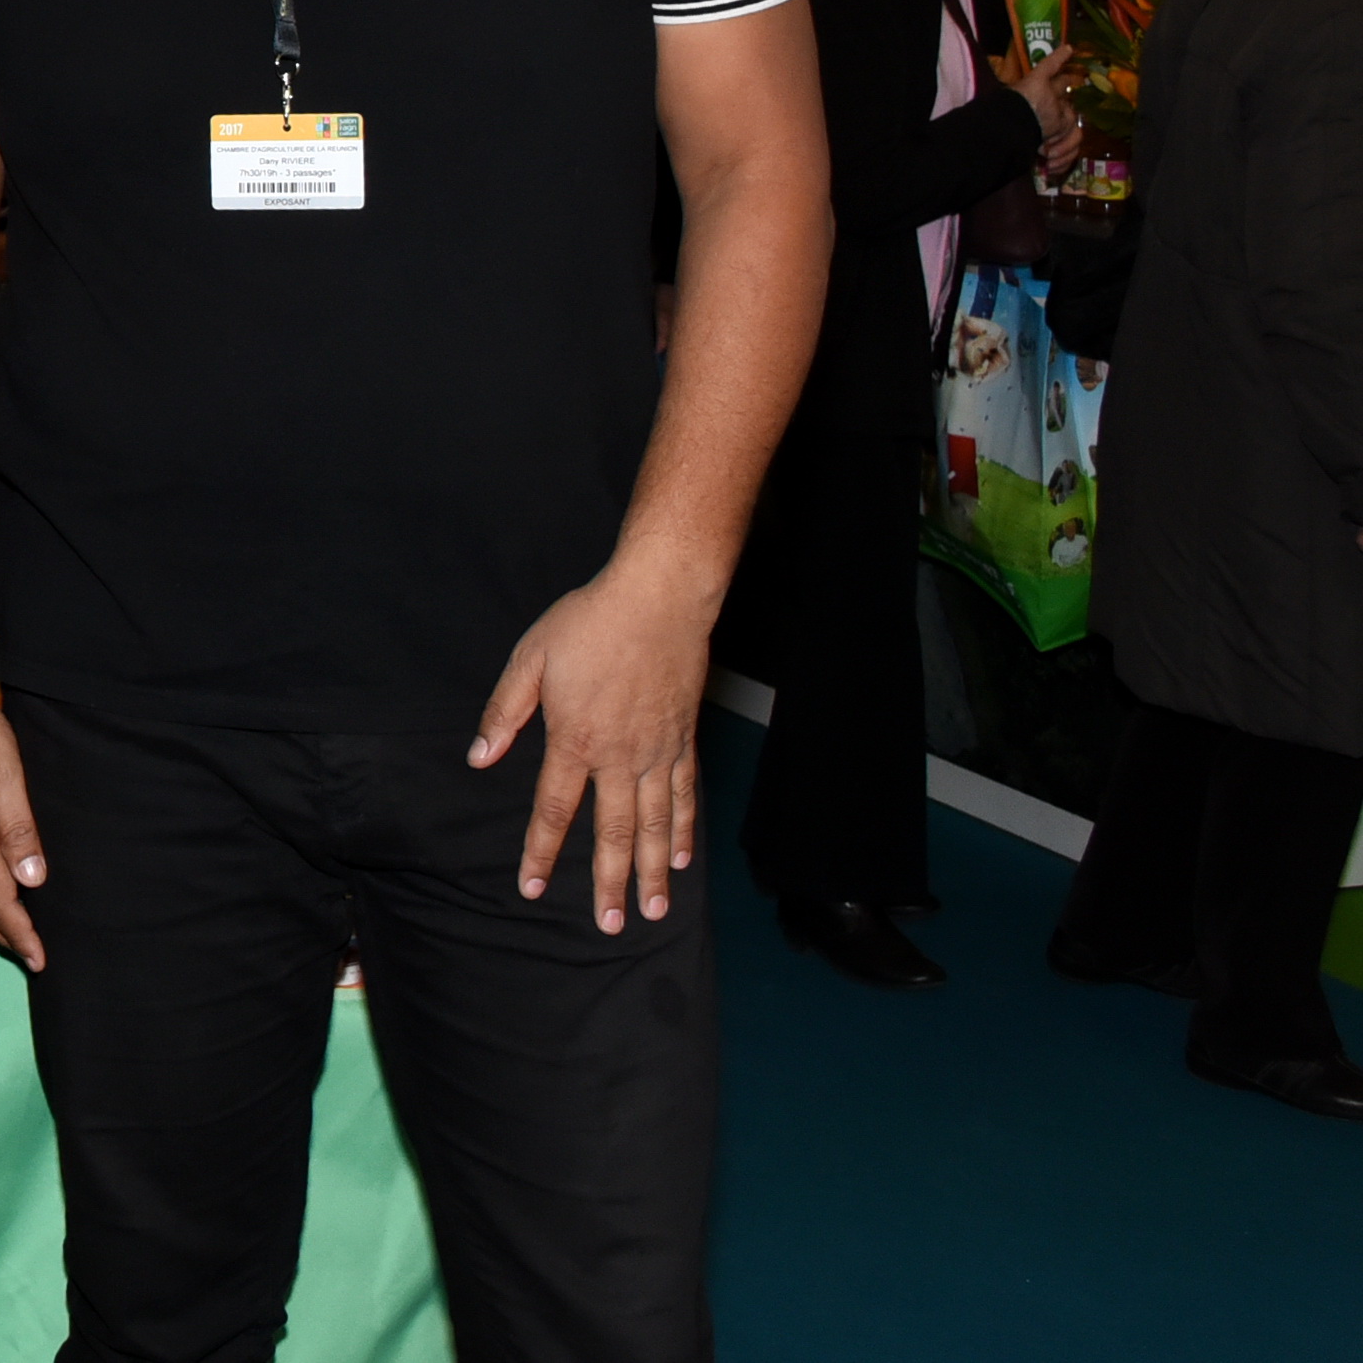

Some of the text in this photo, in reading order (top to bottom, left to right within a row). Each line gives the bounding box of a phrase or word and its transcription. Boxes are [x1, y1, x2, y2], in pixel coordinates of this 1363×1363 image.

[219, 123, 243, 136] 2017
[259, 157, 315, 166] Dany RIVIERE
[239, 168, 278, 177] 7h30/19h
[264, 198, 311, 206] EXPOSANT
